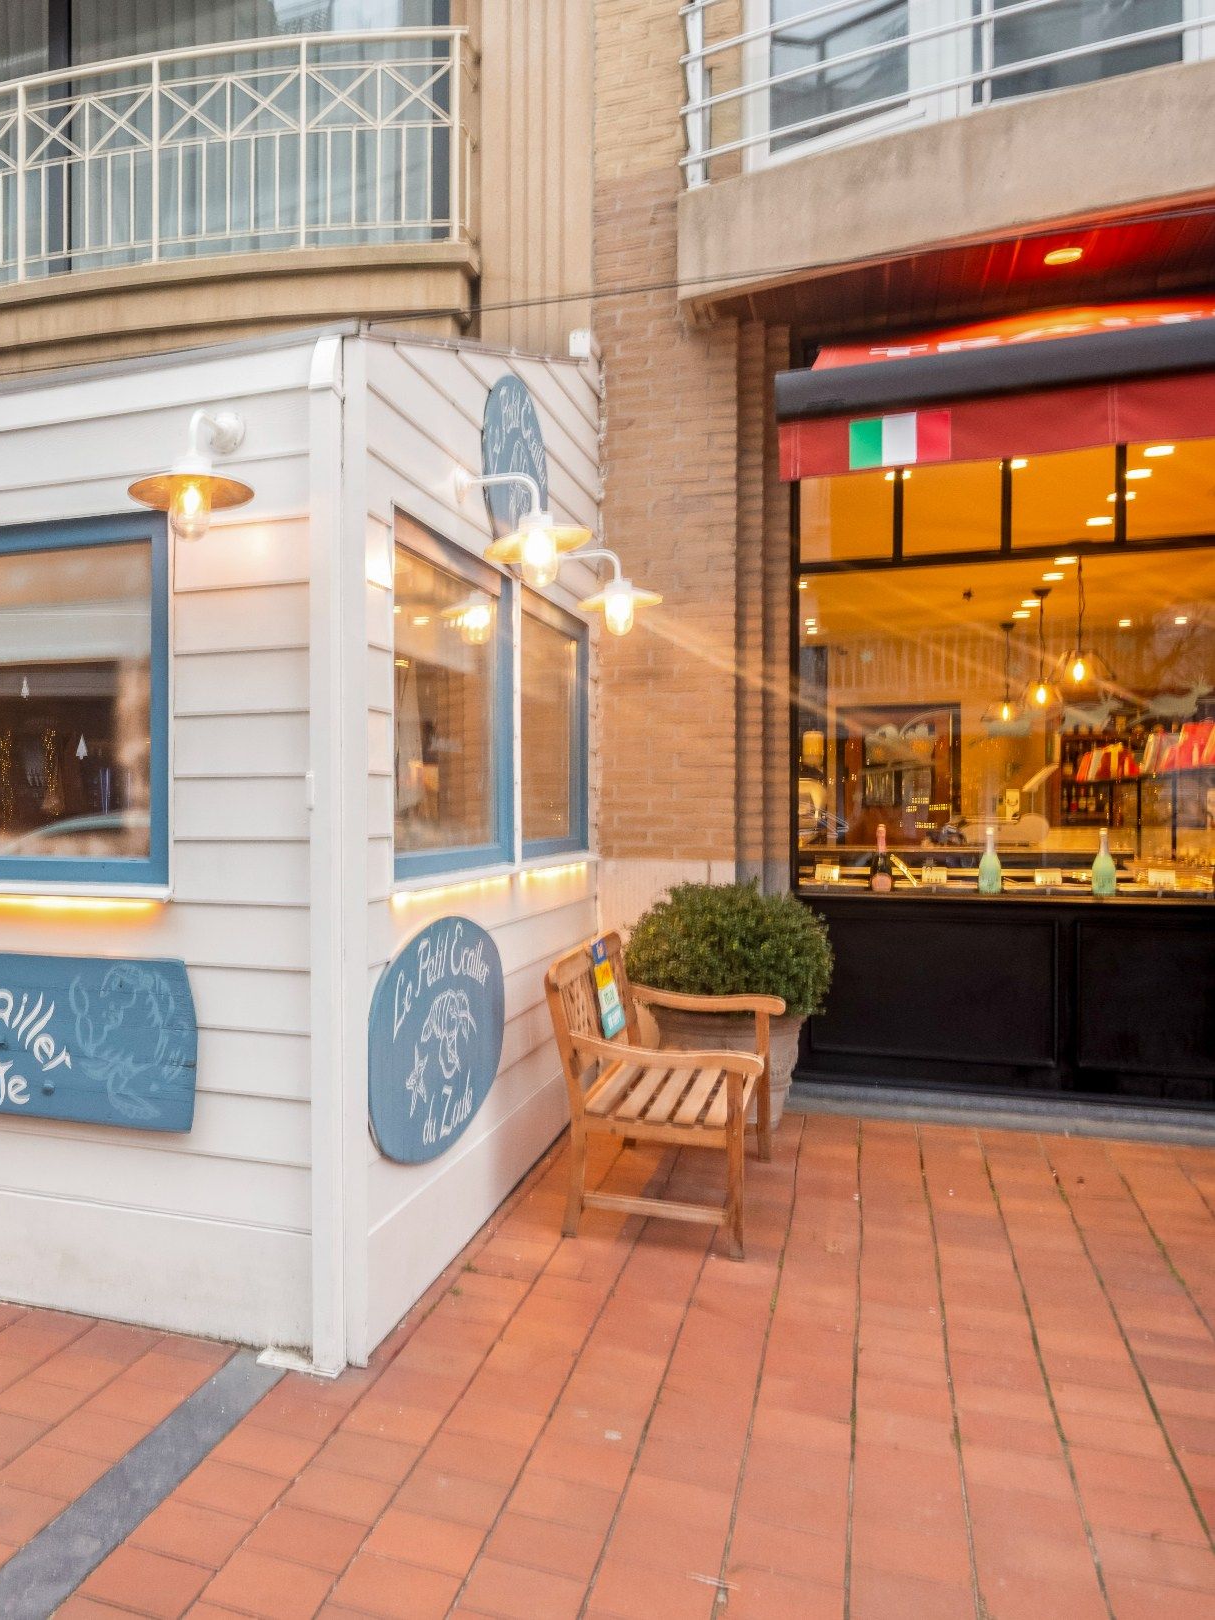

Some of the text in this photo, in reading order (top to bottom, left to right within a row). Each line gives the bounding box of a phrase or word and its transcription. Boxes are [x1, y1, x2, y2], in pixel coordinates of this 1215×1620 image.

[392, 921, 490, 1043] Le Petit Ecailler
[422, 1069, 474, 1146] du Zoute
